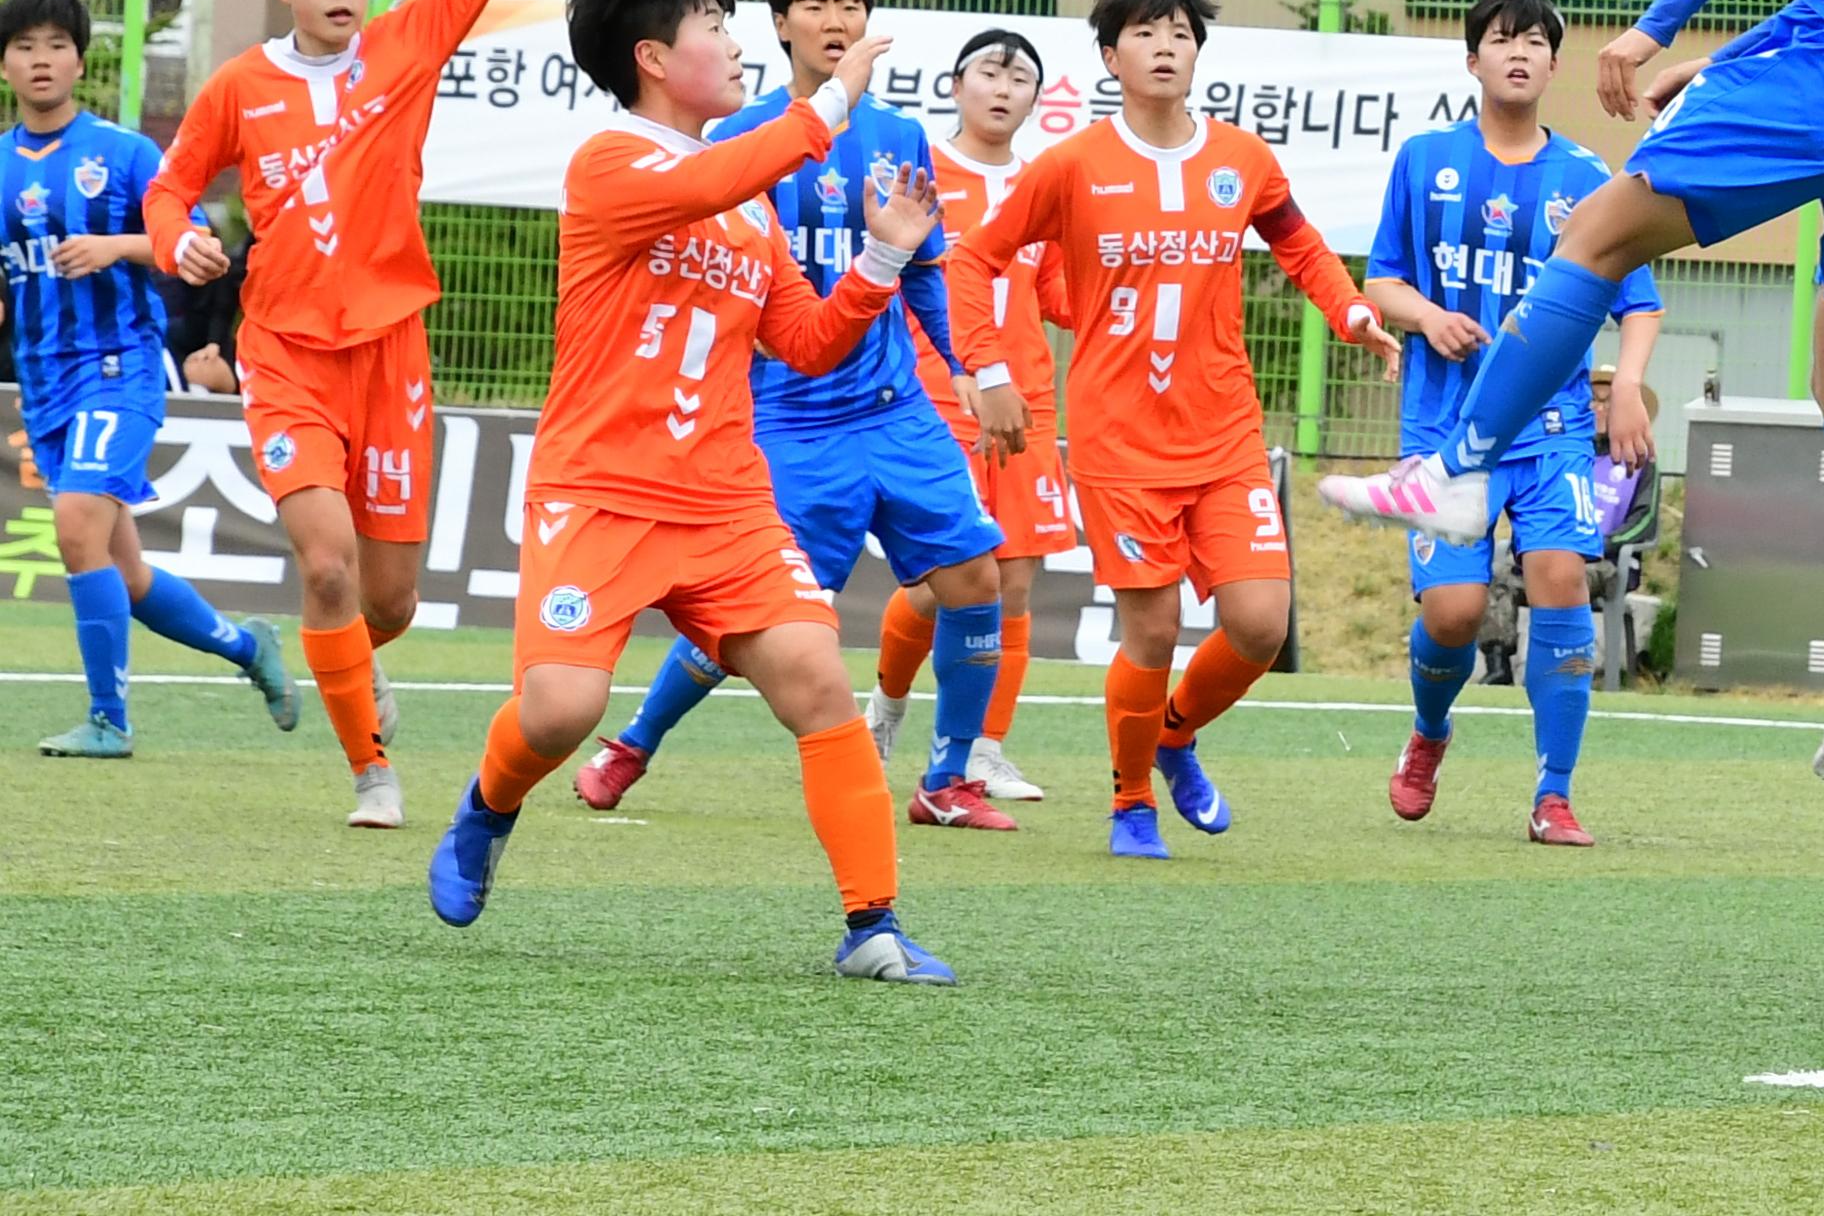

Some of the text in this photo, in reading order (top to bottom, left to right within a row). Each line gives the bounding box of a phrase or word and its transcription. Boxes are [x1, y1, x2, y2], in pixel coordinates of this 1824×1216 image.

[1097, 230, 1240, 268] 동산정산고
[1108, 286, 1139, 337] 9
[71, 410, 118, 461] 17
[364, 445, 411, 501] 14
[1036, 475, 1064, 518] 4
[1247, 487, 1280, 537] 9
